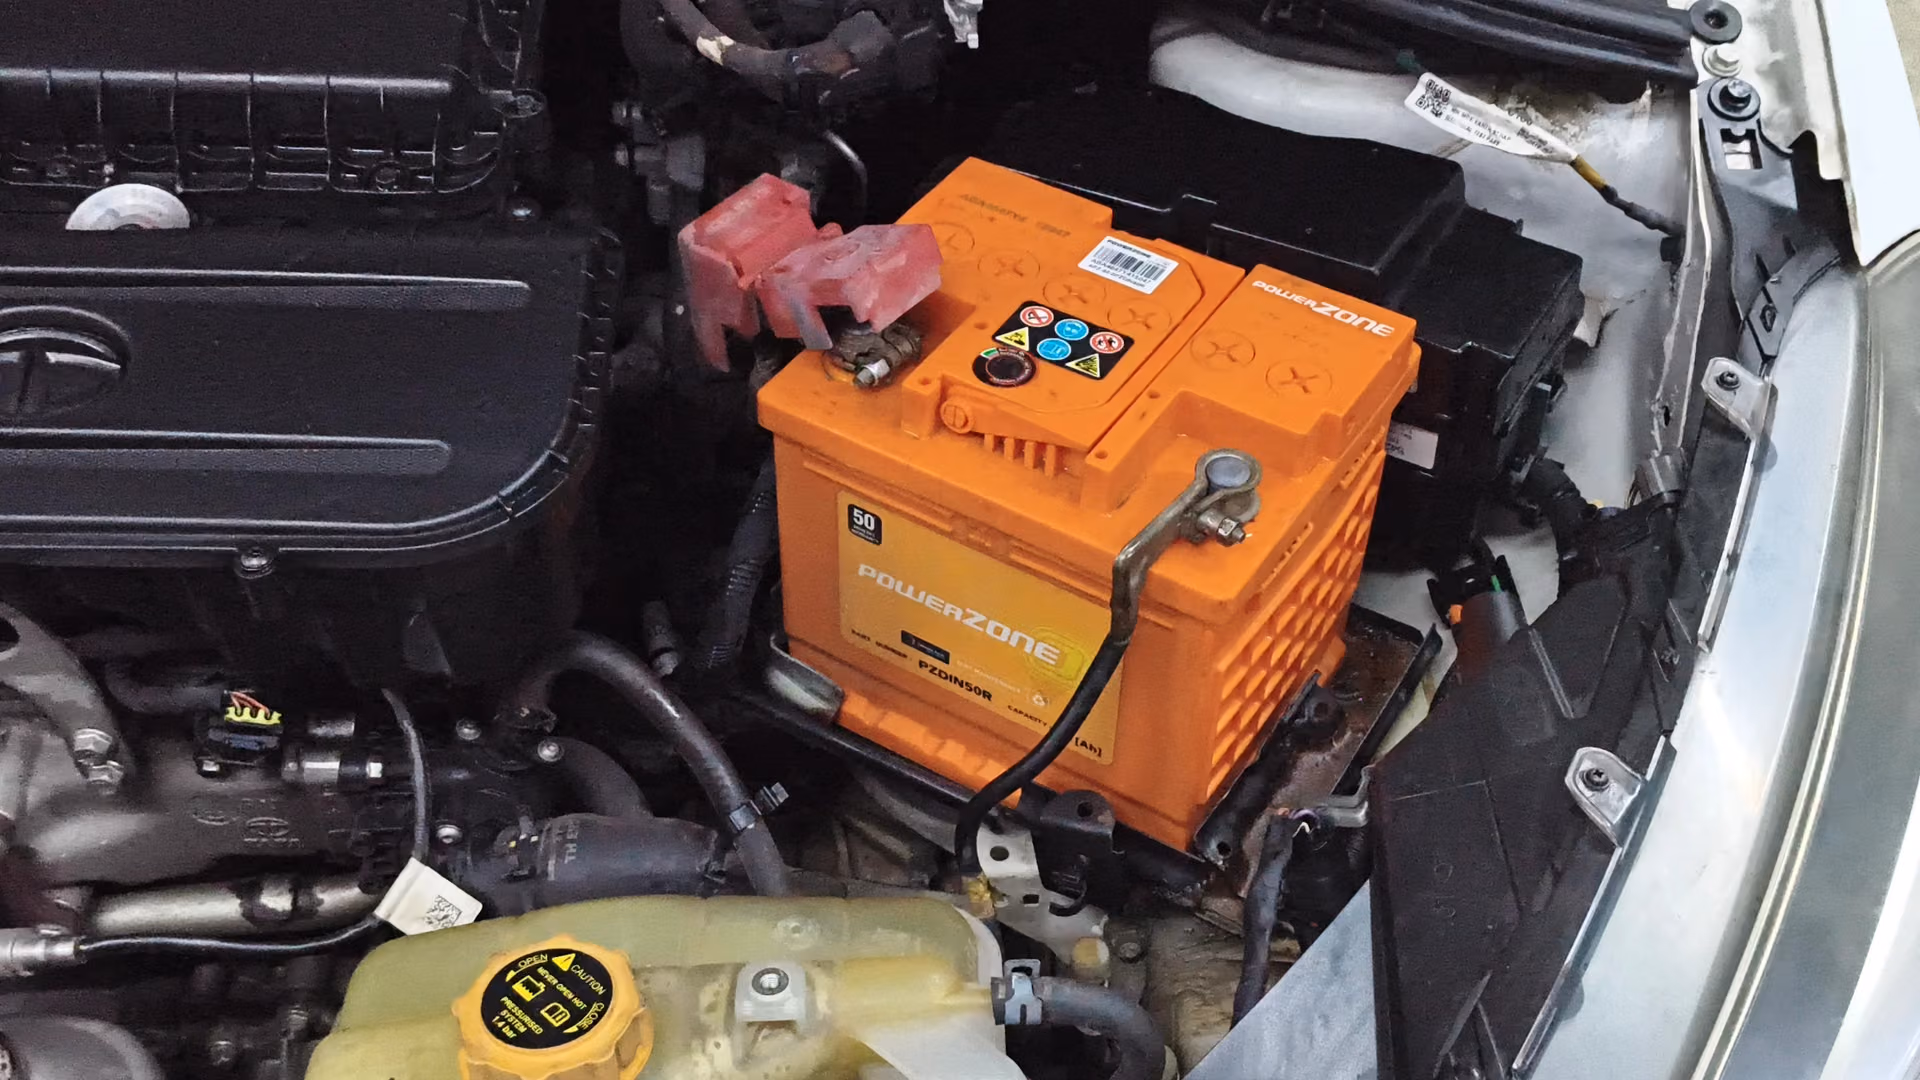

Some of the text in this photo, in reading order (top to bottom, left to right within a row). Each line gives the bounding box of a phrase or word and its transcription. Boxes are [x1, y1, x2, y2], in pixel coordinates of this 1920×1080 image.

[1252, 280, 1395, 337] POWERZONE
[853, 507, 875, 531] 50
[857, 563, 1061, 665] POWERZONE
[918, 659, 993, 701] PZDIN50R
[518, 953, 548, 968] OPEN
[536, 966, 587, 1010] NEVER OPEN HOT
[570, 964, 606, 995] CAUTION
[499, 1009, 527, 1033] SYSTEM
[500, 996, 544, 1035] PRESSURISED
[581, 1002, 605, 1030] CLOSE
[502, 1024, 517, 1039] bar
